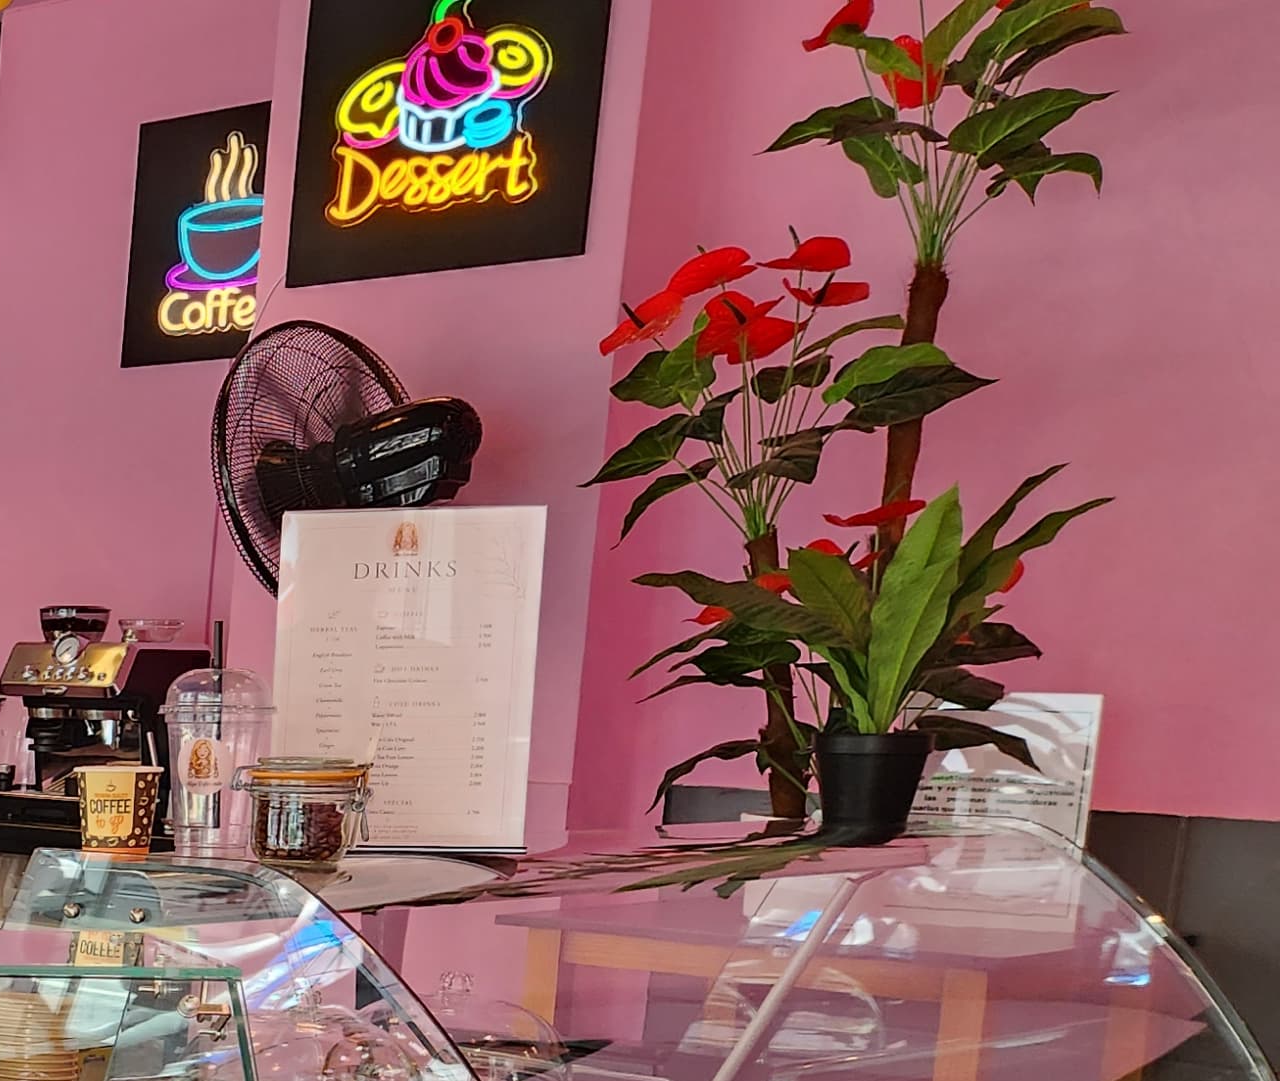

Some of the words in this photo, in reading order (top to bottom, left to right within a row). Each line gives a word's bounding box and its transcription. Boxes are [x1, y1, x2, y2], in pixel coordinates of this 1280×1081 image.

[336, 138, 530, 220] Dessert
[160, 289, 256, 331] Coffe
[353, 560, 457, 580] DRINKS
[89, 798, 131, 815] COFFEE
